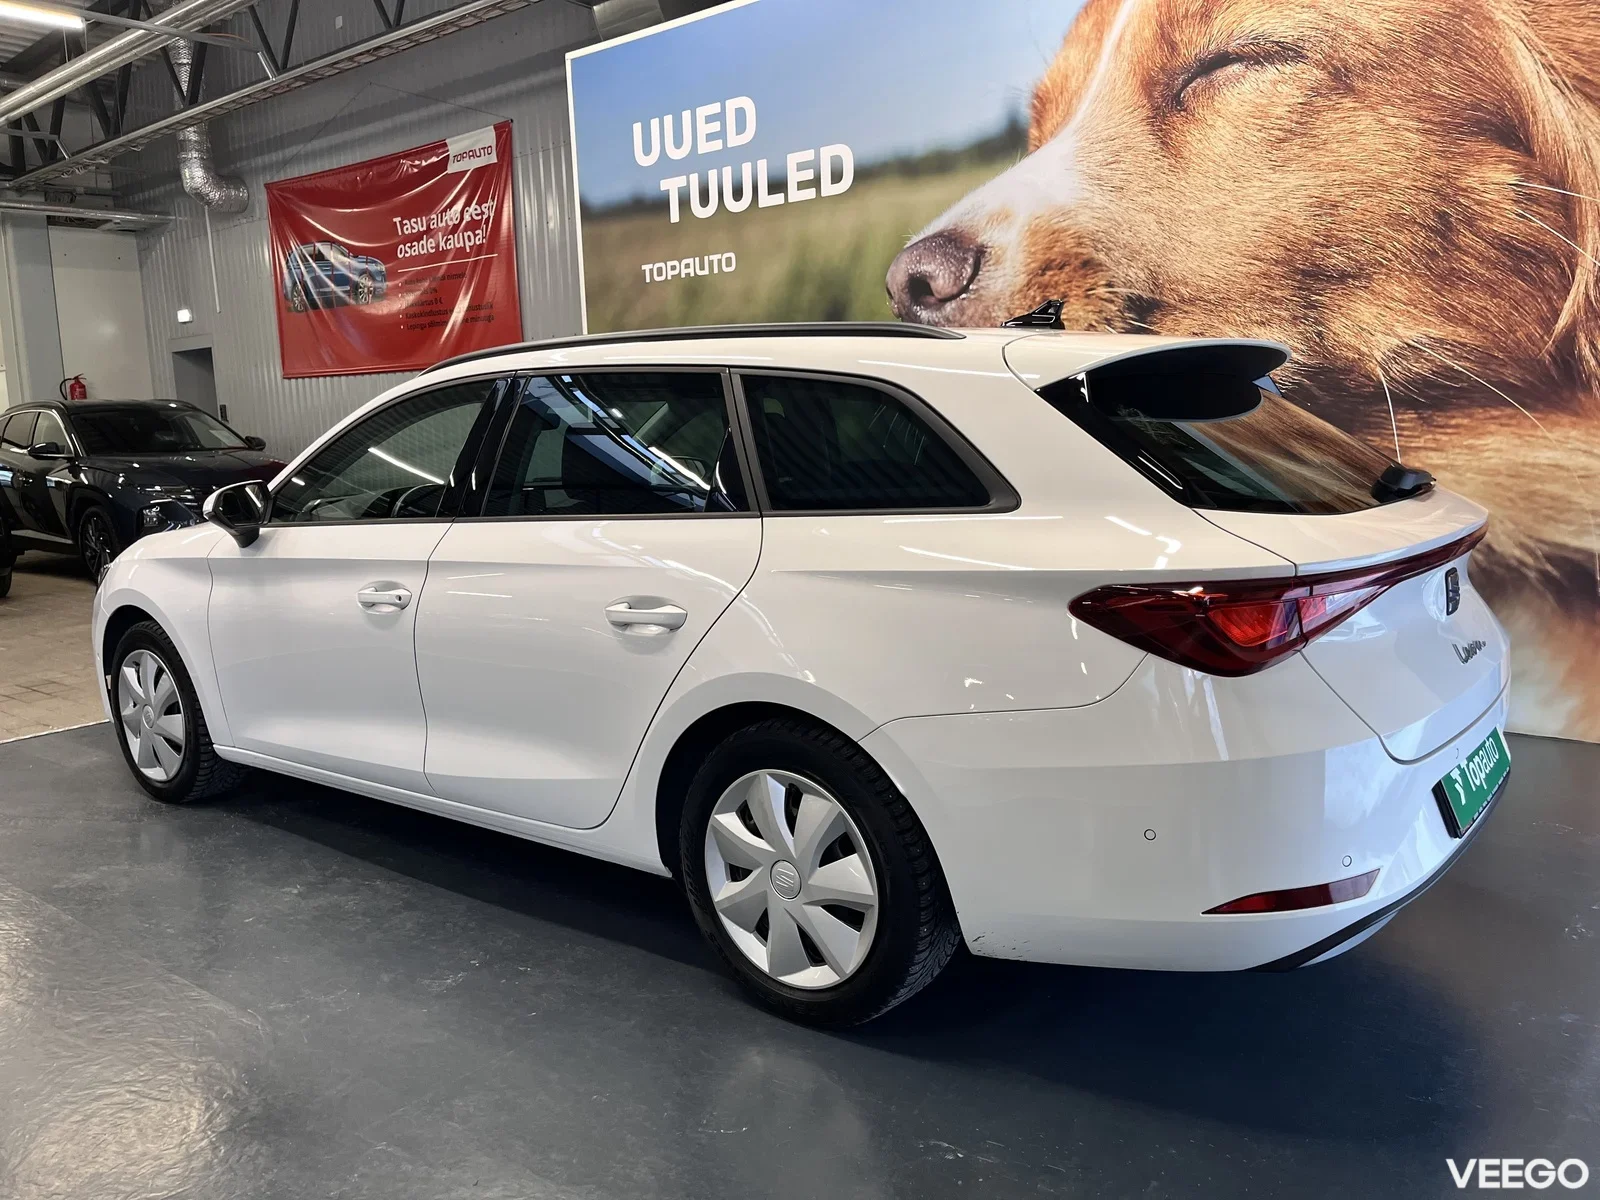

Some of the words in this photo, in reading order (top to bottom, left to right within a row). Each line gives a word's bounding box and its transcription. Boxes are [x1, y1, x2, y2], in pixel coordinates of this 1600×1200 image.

[633, 95, 757, 167] UUED
[453, 146, 493, 163] TOPAUTO
[659, 143, 855, 224] TUULED
[393, 216, 427, 236] Tasu
[430, 208, 461, 230] auto
[463, 199, 495, 222] eest
[397, 234, 436, 259] osade
[439, 224, 487, 253] kaupa!
[641, 252, 737, 283] TOPAUTO
[1460, 736, 1500, 792] Topauto
